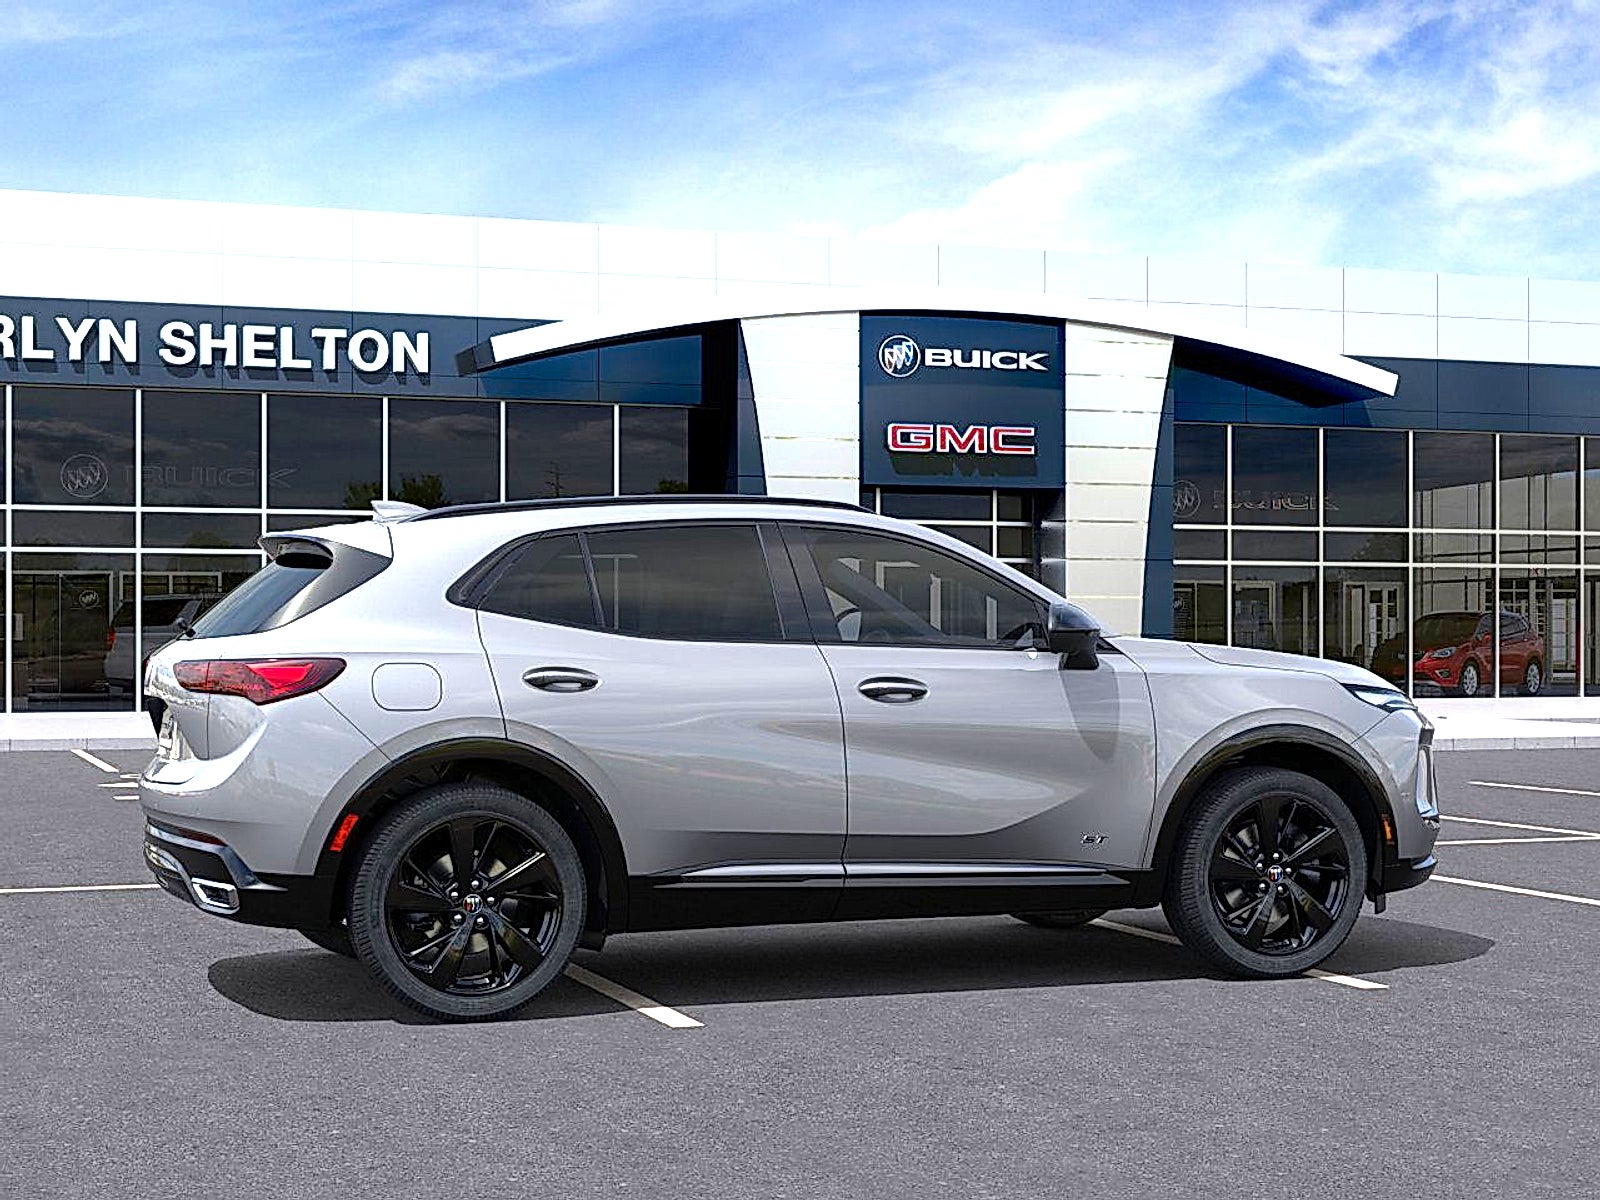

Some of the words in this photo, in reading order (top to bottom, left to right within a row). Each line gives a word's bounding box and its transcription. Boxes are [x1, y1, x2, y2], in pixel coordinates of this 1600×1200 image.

[159, 321, 429, 373] SHELTON
[924, 347, 1049, 371] BUICK
[887, 423, 1036, 455] GMC
